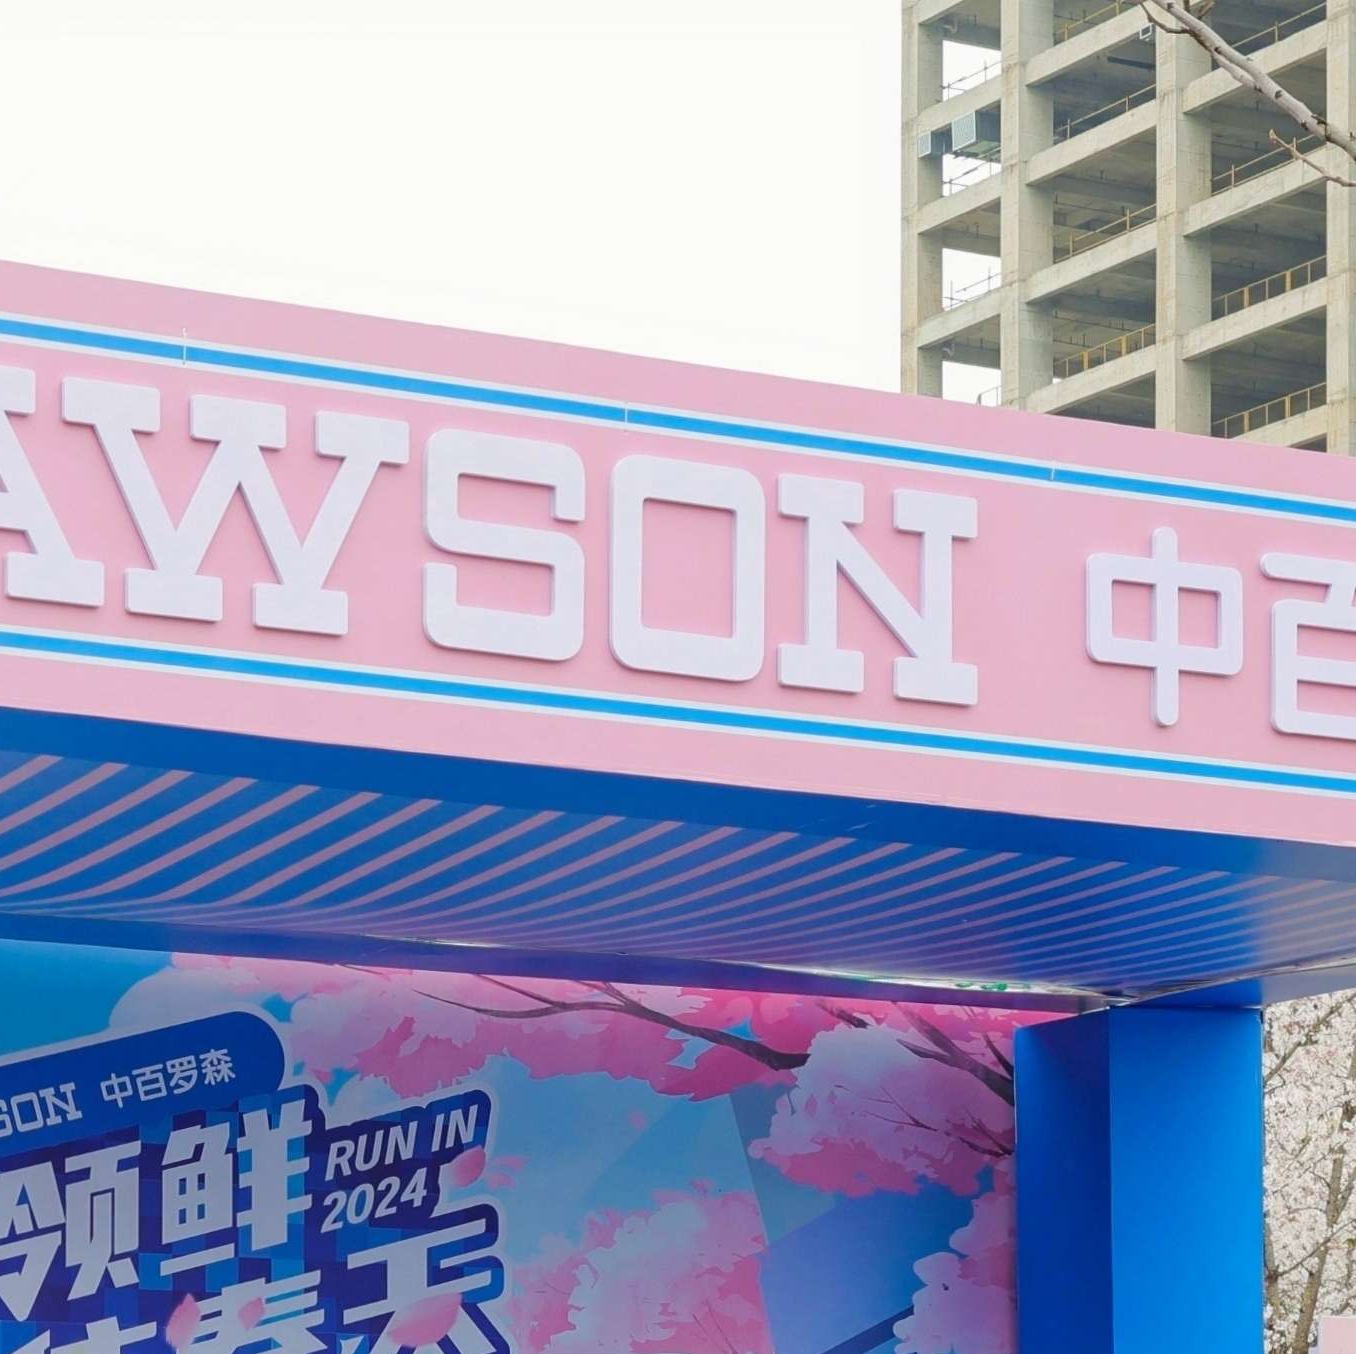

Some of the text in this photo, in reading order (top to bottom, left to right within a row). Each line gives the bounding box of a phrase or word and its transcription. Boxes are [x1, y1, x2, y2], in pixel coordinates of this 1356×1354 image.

[100, 1049, 237, 1111] 中百罗森
[325, 1102, 480, 1181] RUN IN
[319, 1174, 429, 1235] 2024
